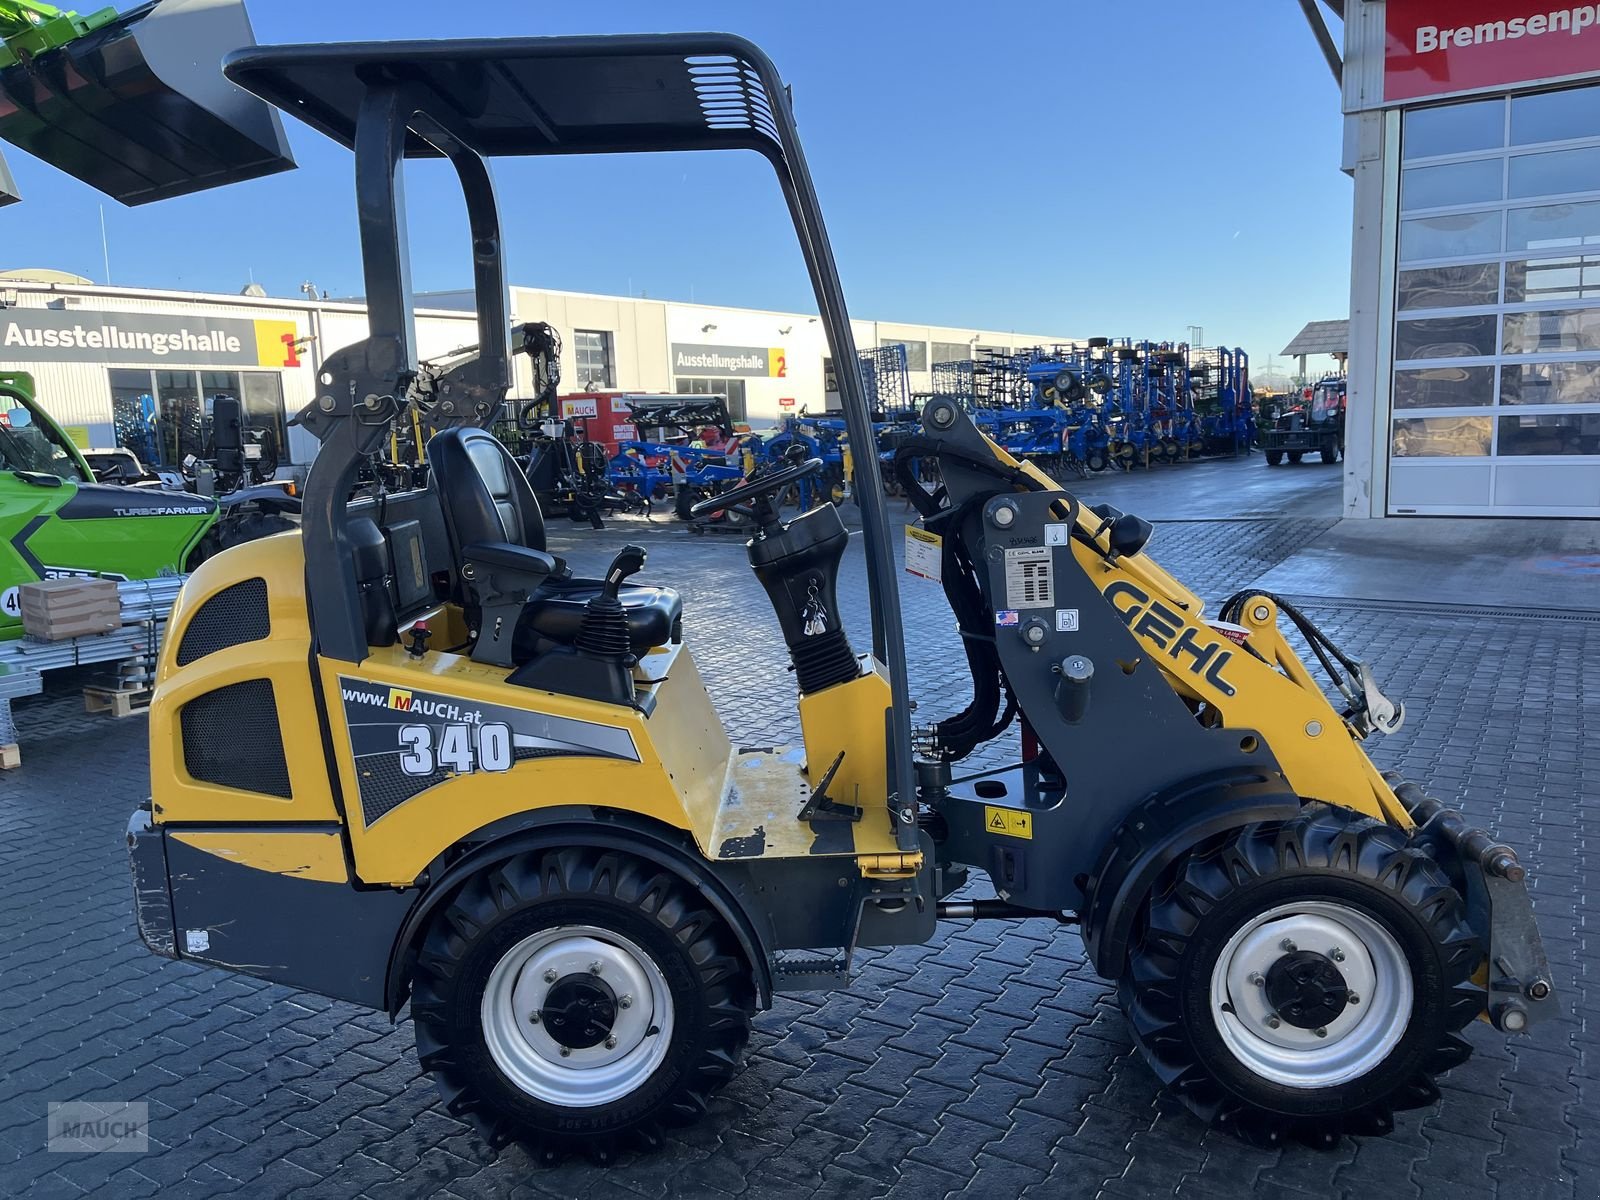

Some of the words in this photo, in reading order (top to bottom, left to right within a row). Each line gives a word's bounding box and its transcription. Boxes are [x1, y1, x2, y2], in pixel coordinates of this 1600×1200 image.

[4, 322, 241, 355] Ausstellungshalle
[281, 333, 301, 368] 1
[676, 351, 764, 371] Ausstellungshalle
[776, 356, 786, 378] 2
[567, 405, 595, 415] MAUCH
[113, 506, 208, 516] TURBOFARMER
[6, 592, 21, 611] 4
[1101, 580, 1237, 697] GEHL
[342, 688, 482, 724] www.MAUCH.at
[398, 722, 513, 777] 340
